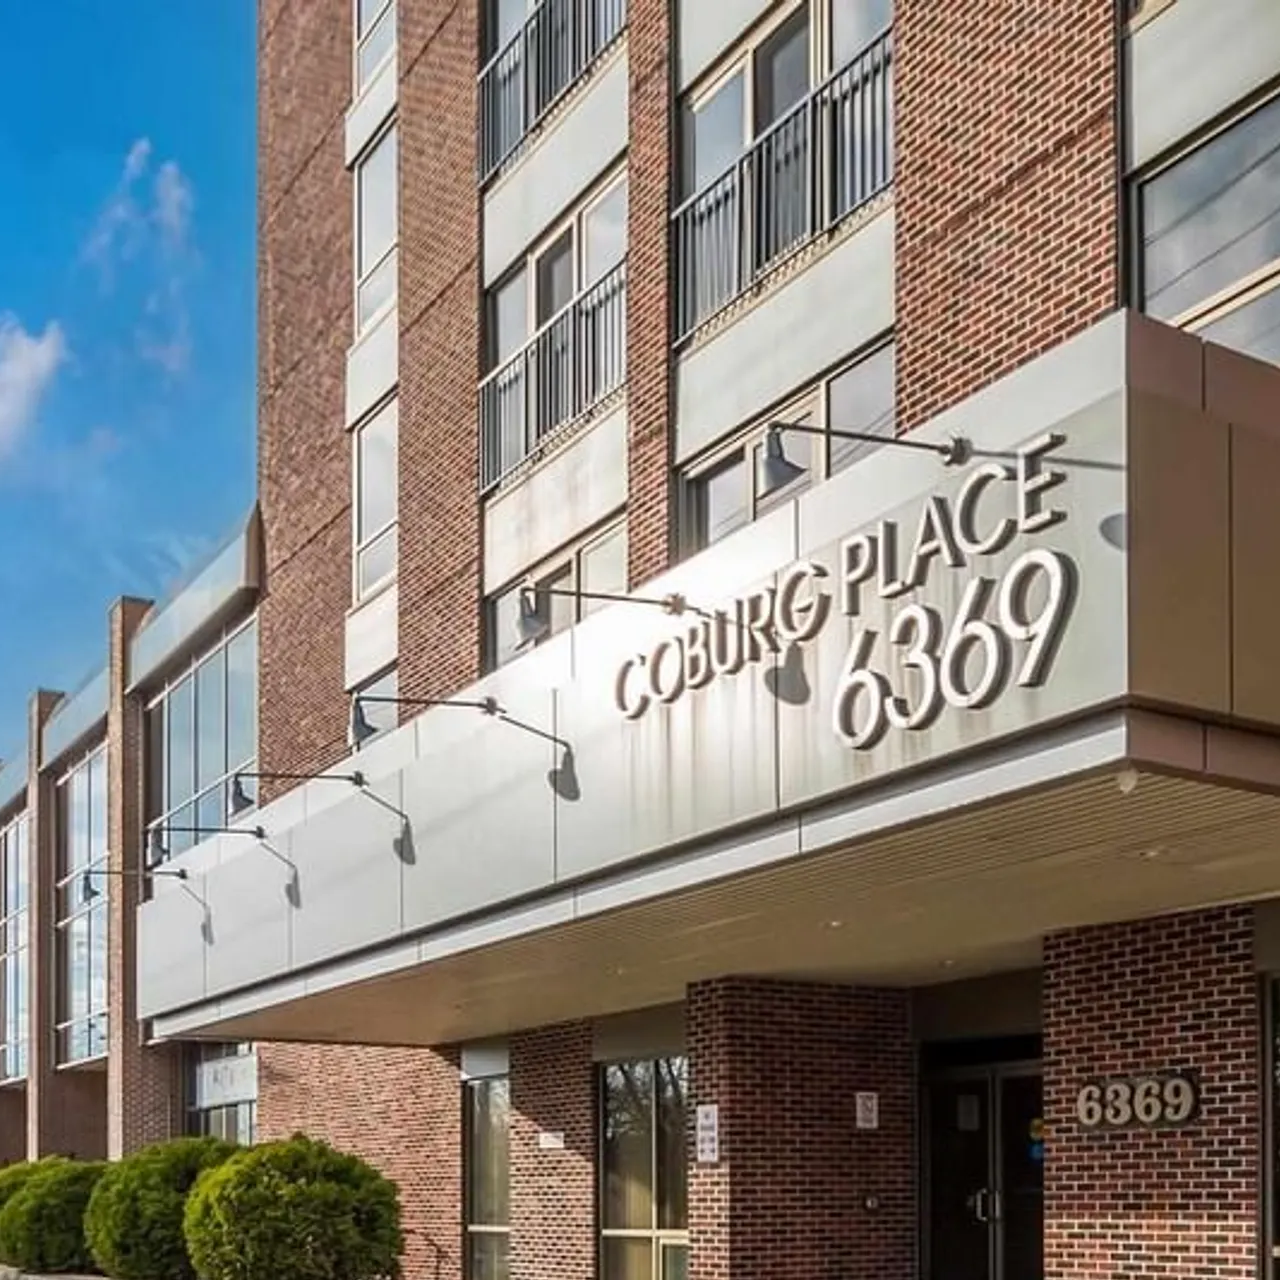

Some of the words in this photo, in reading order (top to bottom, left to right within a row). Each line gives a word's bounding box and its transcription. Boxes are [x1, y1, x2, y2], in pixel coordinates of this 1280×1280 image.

[616, 561, 831, 720] COBURG
[842, 433, 1067, 615] PLACE
[833, 549, 1079, 750] 6369
[1077, 1079, 1194, 1126] 6369
